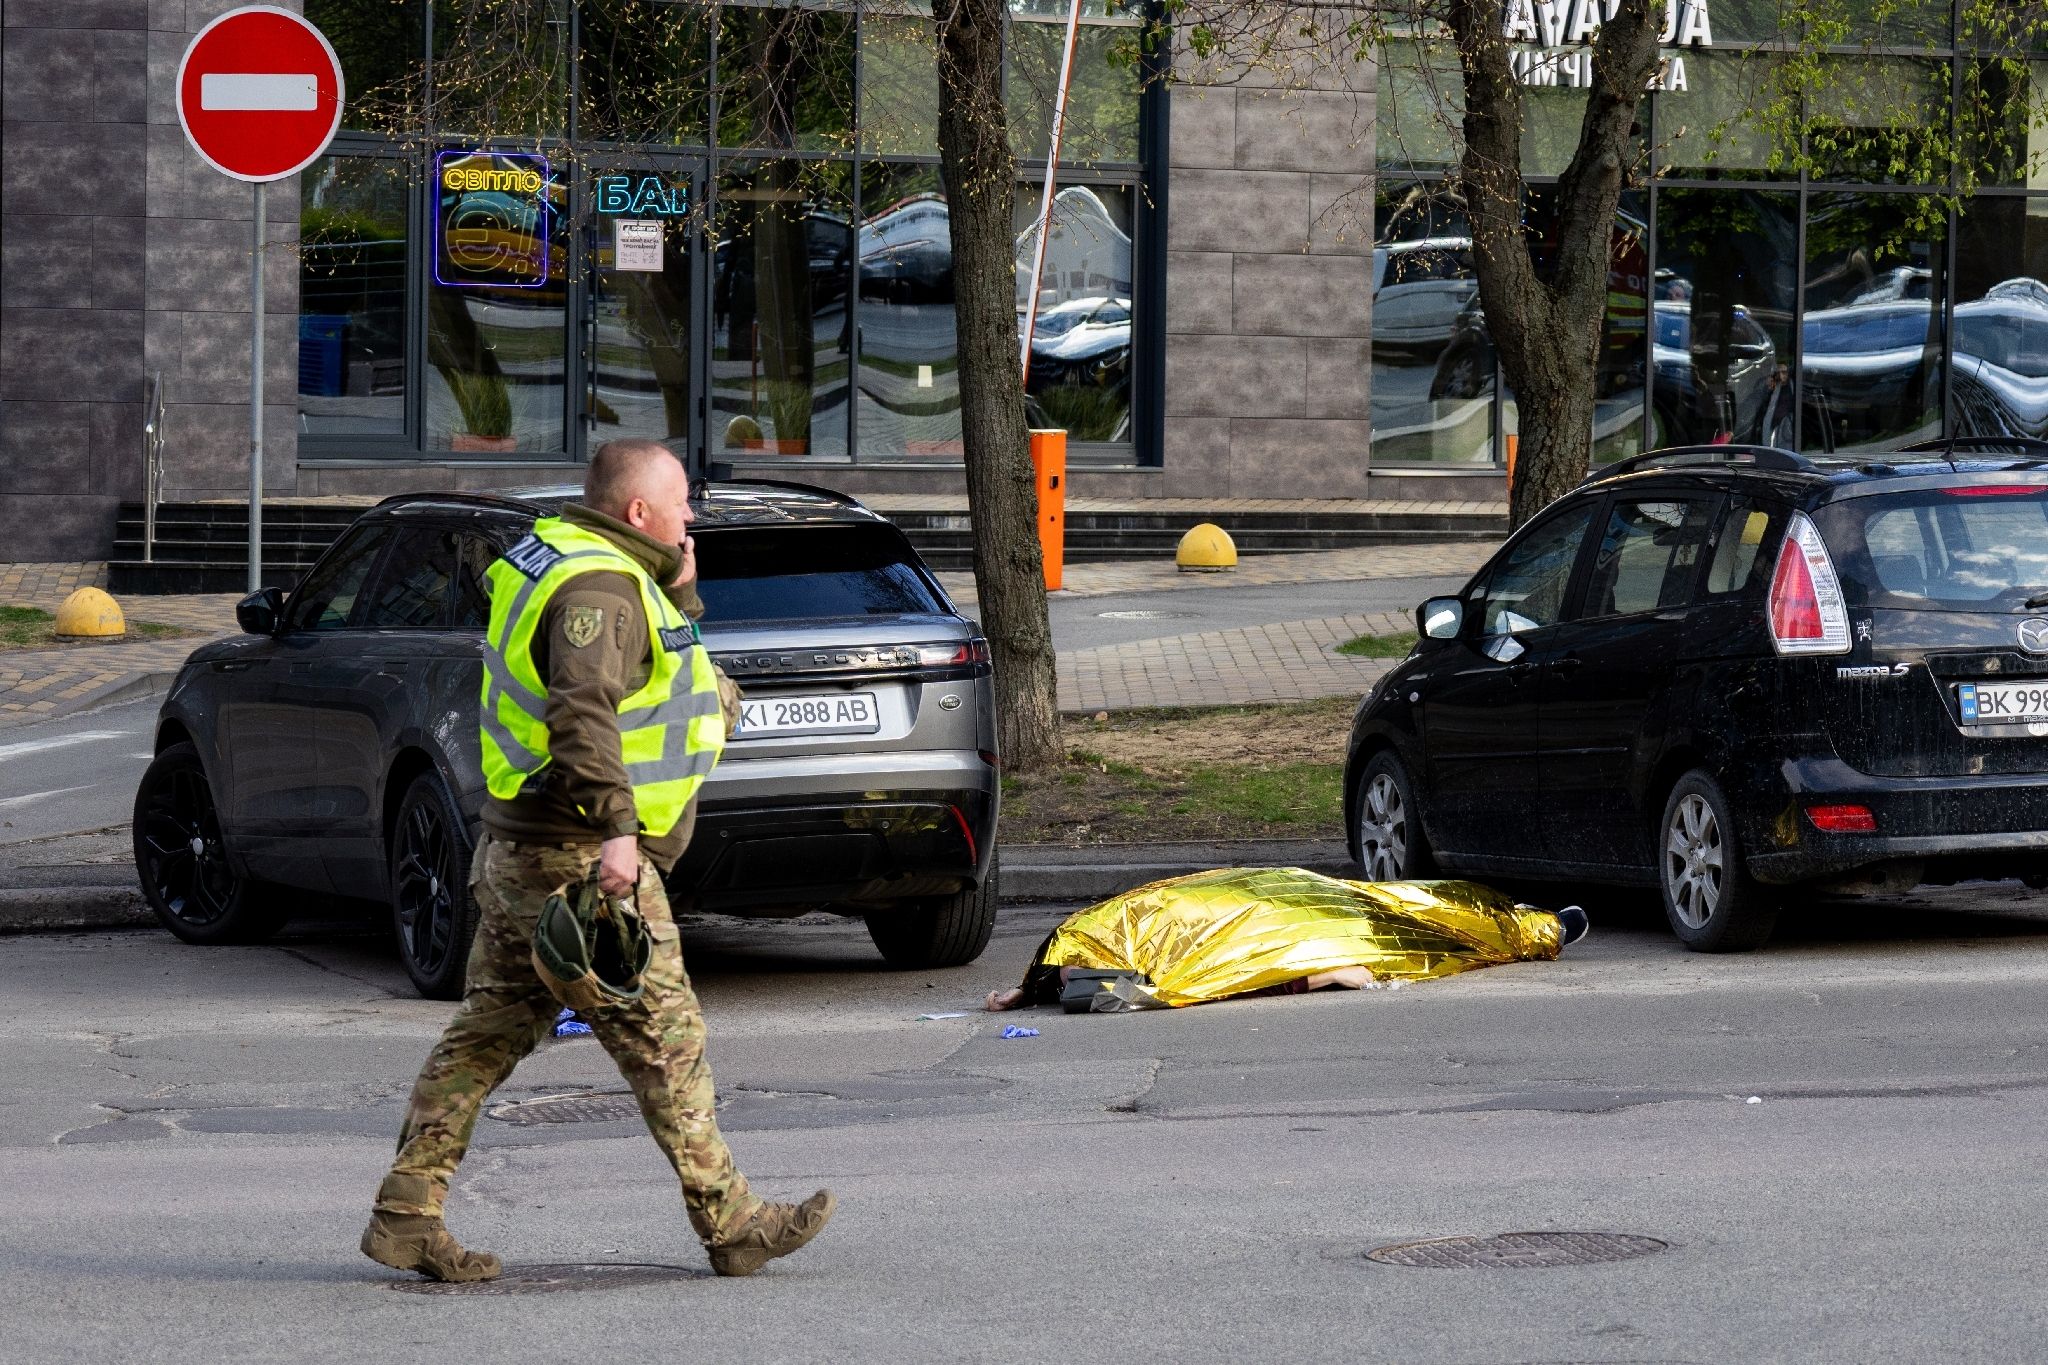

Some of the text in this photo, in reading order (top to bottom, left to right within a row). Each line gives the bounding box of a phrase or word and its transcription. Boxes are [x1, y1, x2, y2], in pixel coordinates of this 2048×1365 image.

[445, 168, 541, 191] СВІТЛО
[1836, 665, 1889, 678] mazda
[775, 701, 830, 725] 2888
[837, 699, 868, 722] AB
[1965, 706, 1976, 715] UA
[1977, 691, 2011, 714] BK
